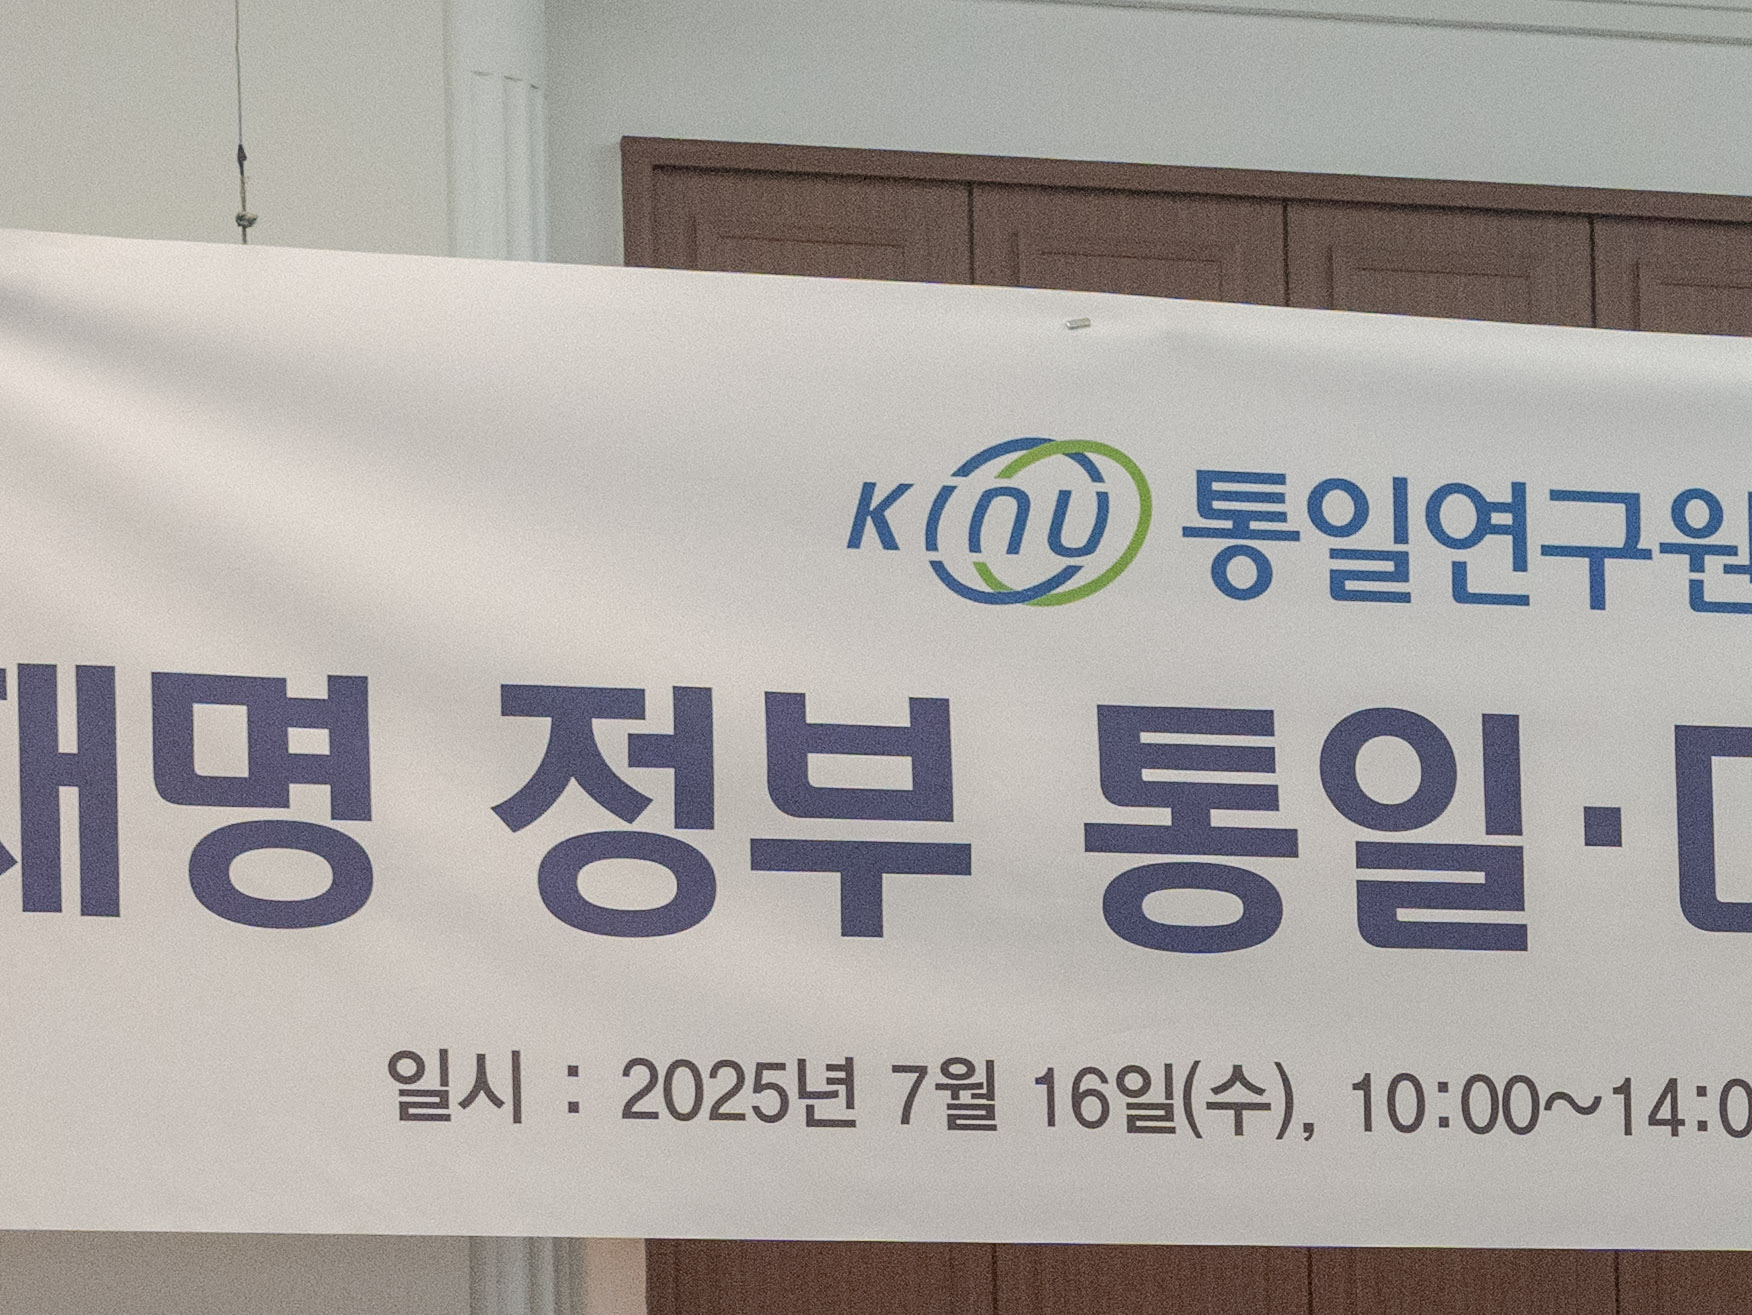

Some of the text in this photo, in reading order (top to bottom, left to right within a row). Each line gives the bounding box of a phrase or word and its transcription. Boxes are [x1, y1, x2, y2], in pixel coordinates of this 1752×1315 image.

[491, 683, 973, 939] 정부
[387, 1048, 523, 1125] 일시
[621, 1056, 857, 1129] 2025년
[891, 1056, 998, 1132] 7월
[1034, 1059, 1315, 1142] 16일(수),
